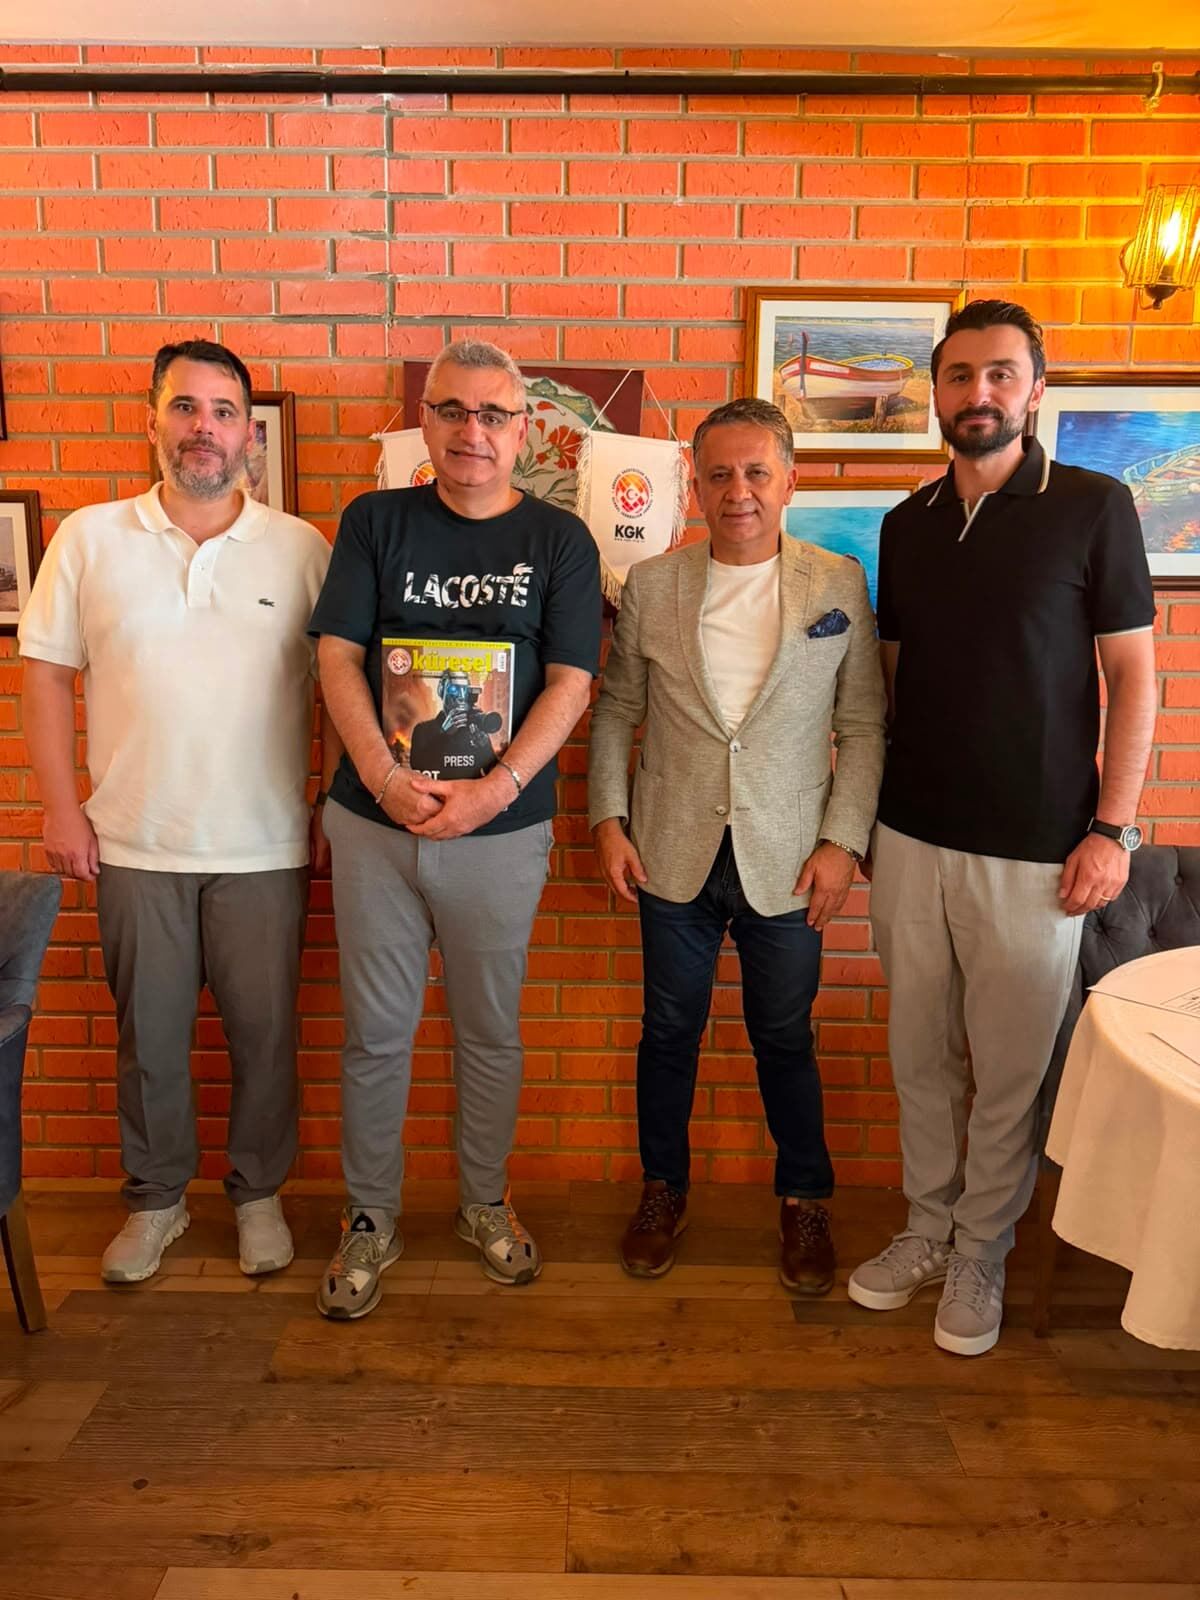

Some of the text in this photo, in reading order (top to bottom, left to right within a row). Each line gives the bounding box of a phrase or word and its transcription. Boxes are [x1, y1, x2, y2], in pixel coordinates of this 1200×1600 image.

[614, 524, 646, 540] KGK
[403, 571, 530, 608] LACOSTE
[412, 649, 492, 673] küresel
[443, 755, 475, 768] PRESS
